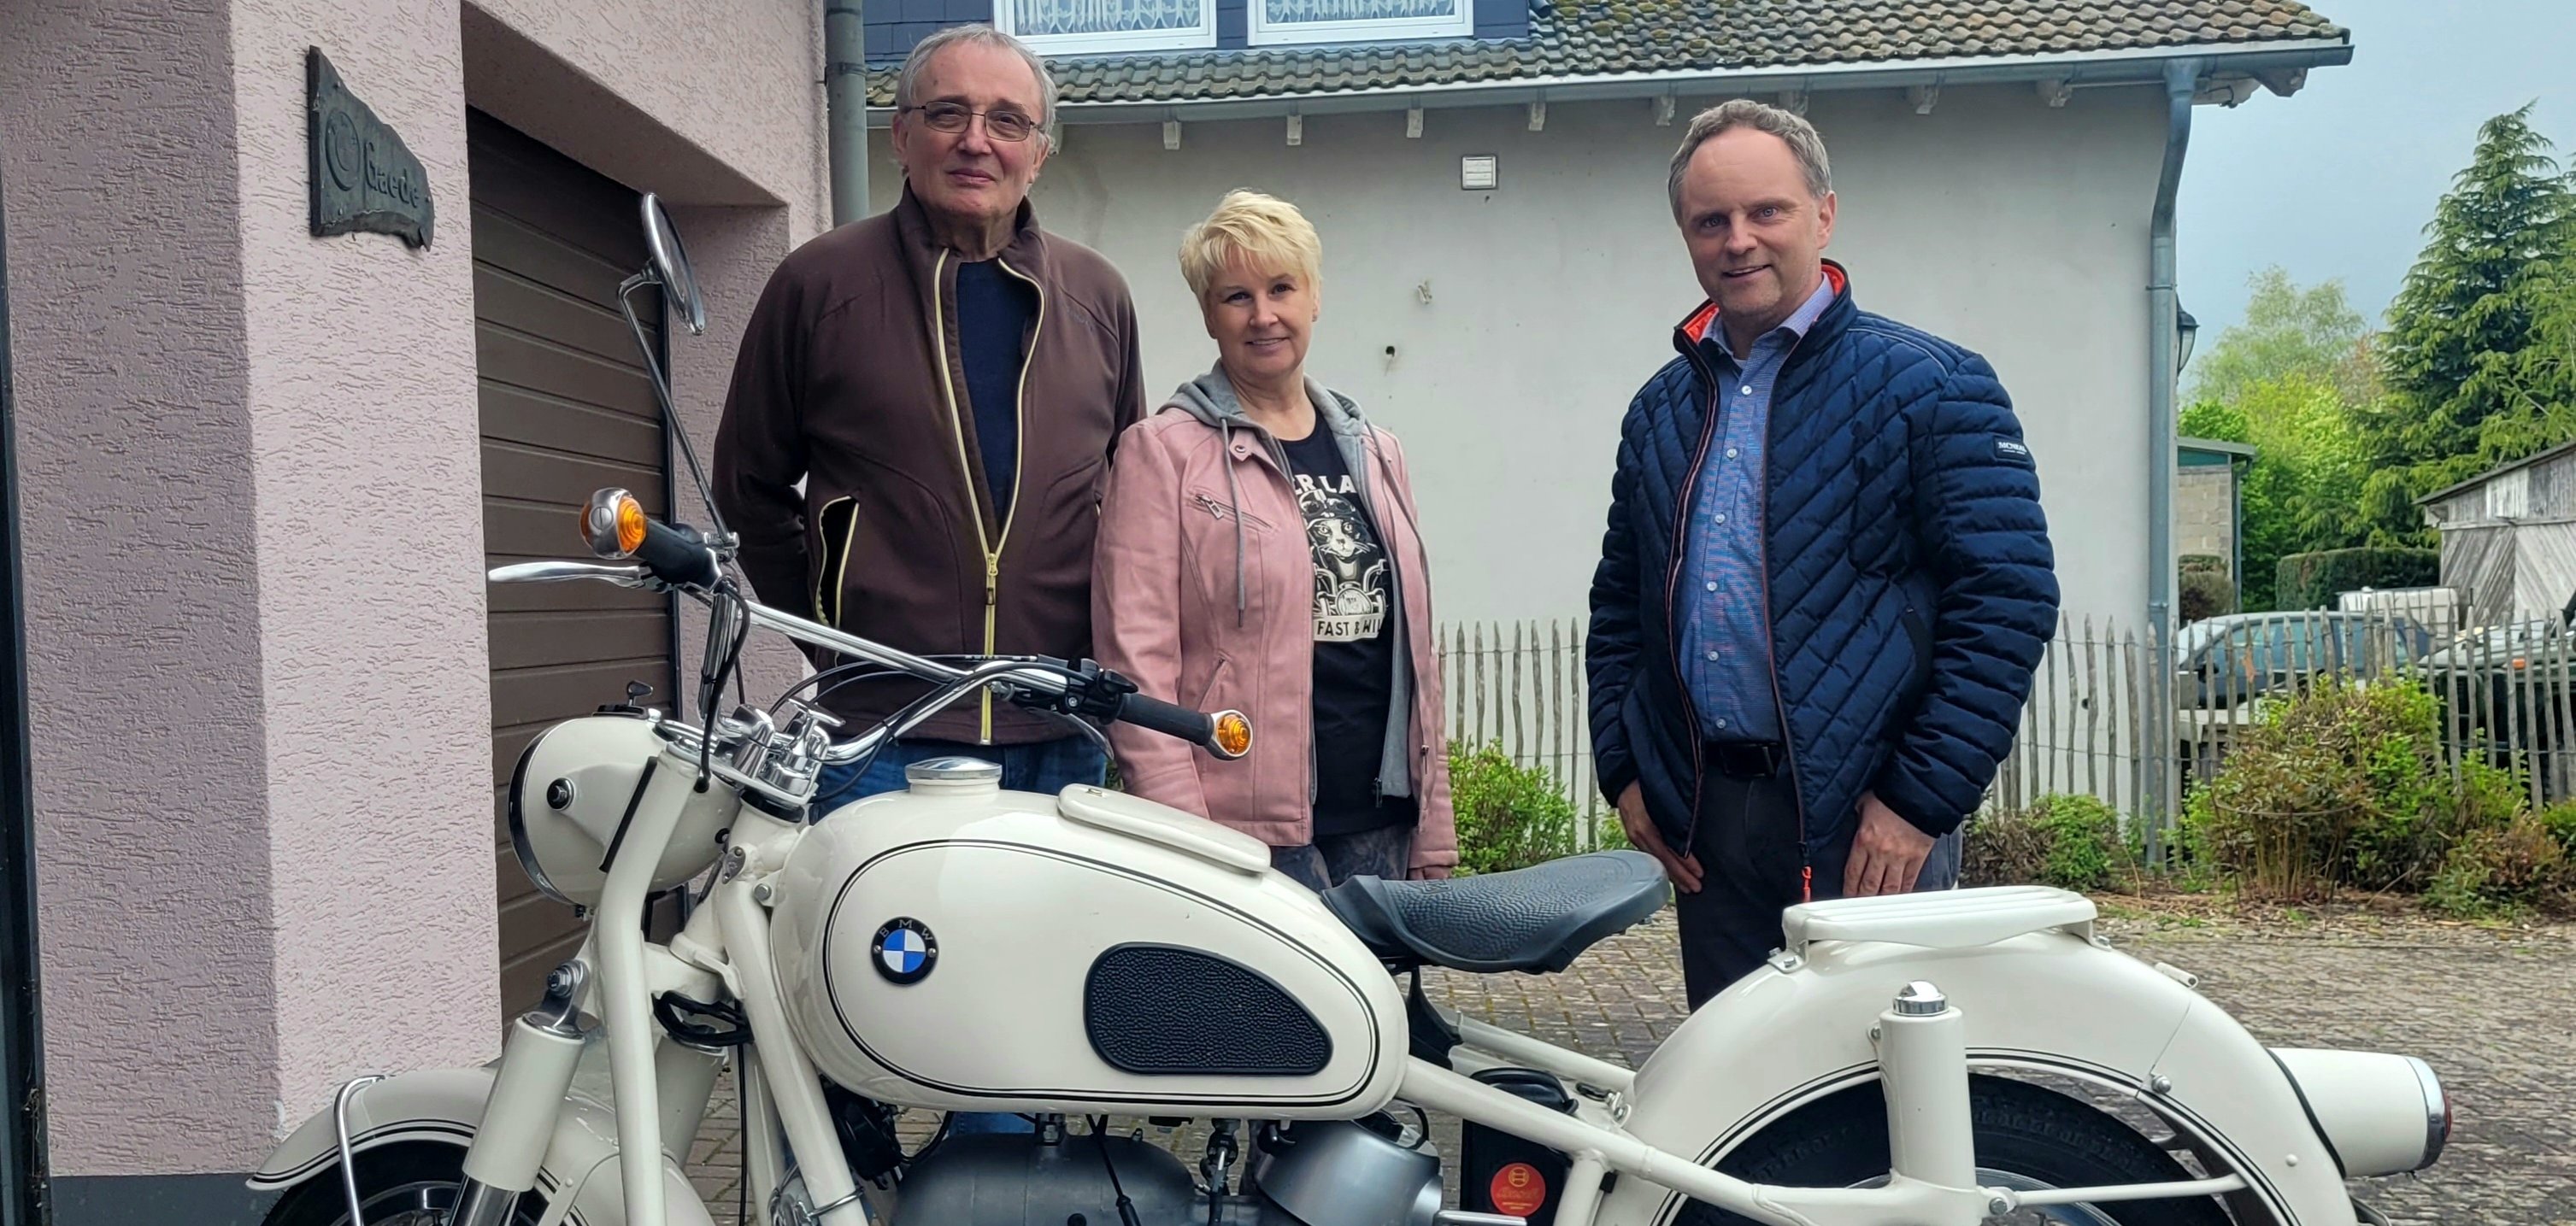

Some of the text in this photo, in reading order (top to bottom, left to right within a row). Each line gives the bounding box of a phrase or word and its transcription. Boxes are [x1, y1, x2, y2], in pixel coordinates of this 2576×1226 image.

[363, 141, 420, 208] Gaede
[1317, 620, 1350, 636] FAST
[1355, 621, 1360, 635] &
[879, 919, 933, 941] BMW
